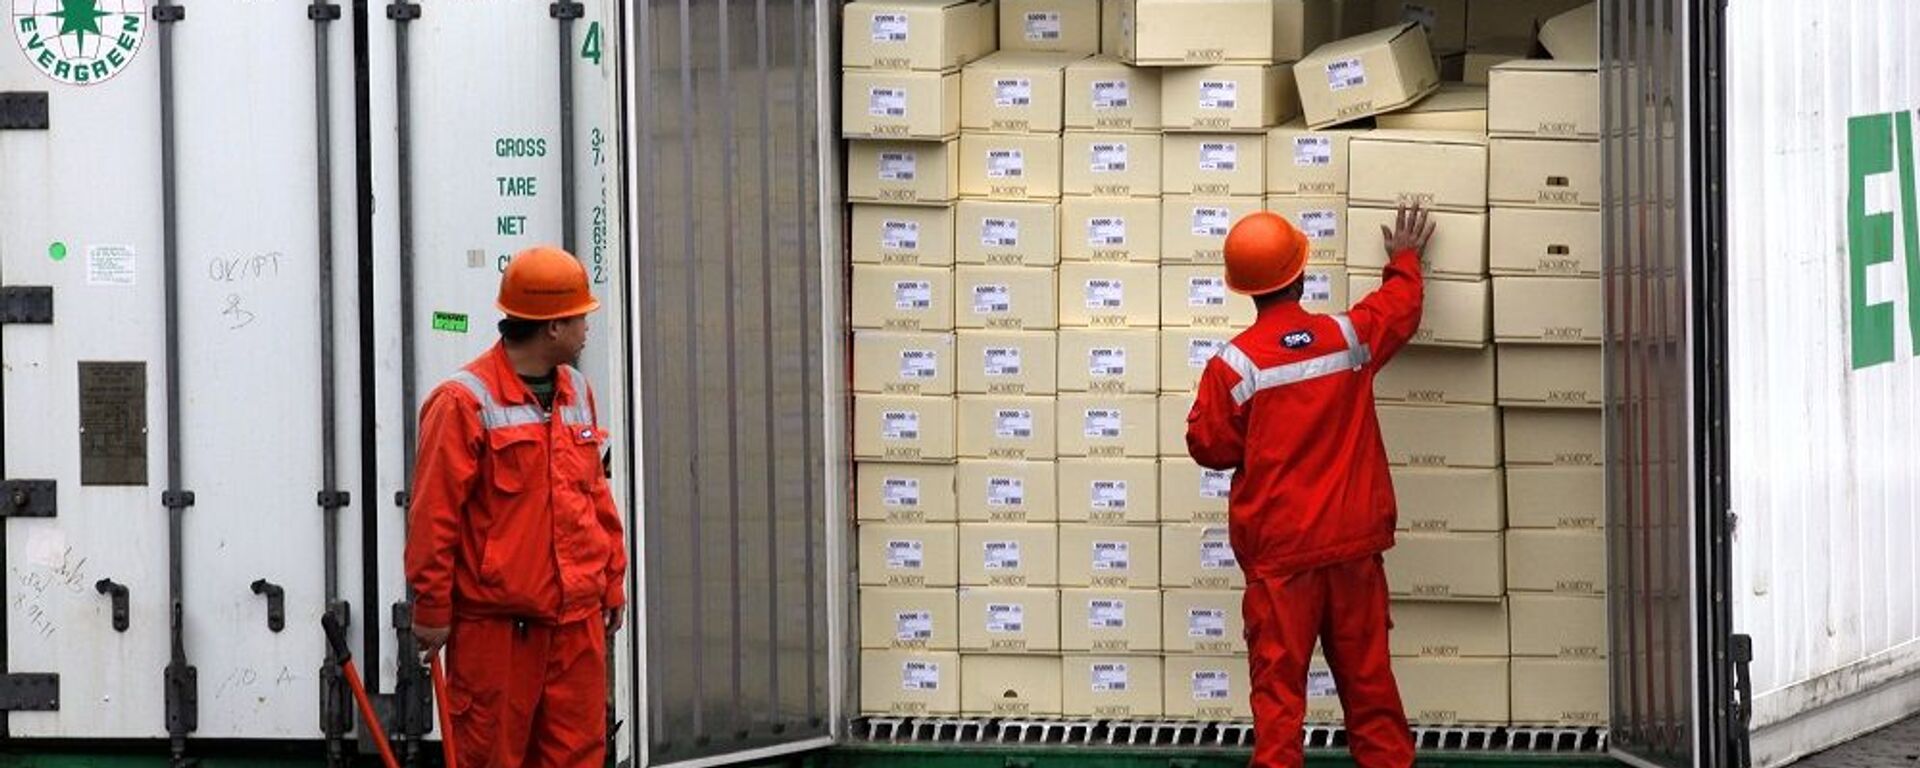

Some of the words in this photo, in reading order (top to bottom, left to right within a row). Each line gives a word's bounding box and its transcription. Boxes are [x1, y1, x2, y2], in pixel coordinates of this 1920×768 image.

[20, 15, 139, 81] EVERGREEN
[496, 138, 546, 157] GROSS
[496, 177, 537, 196] TARE
[497, 216, 527, 235] NET
